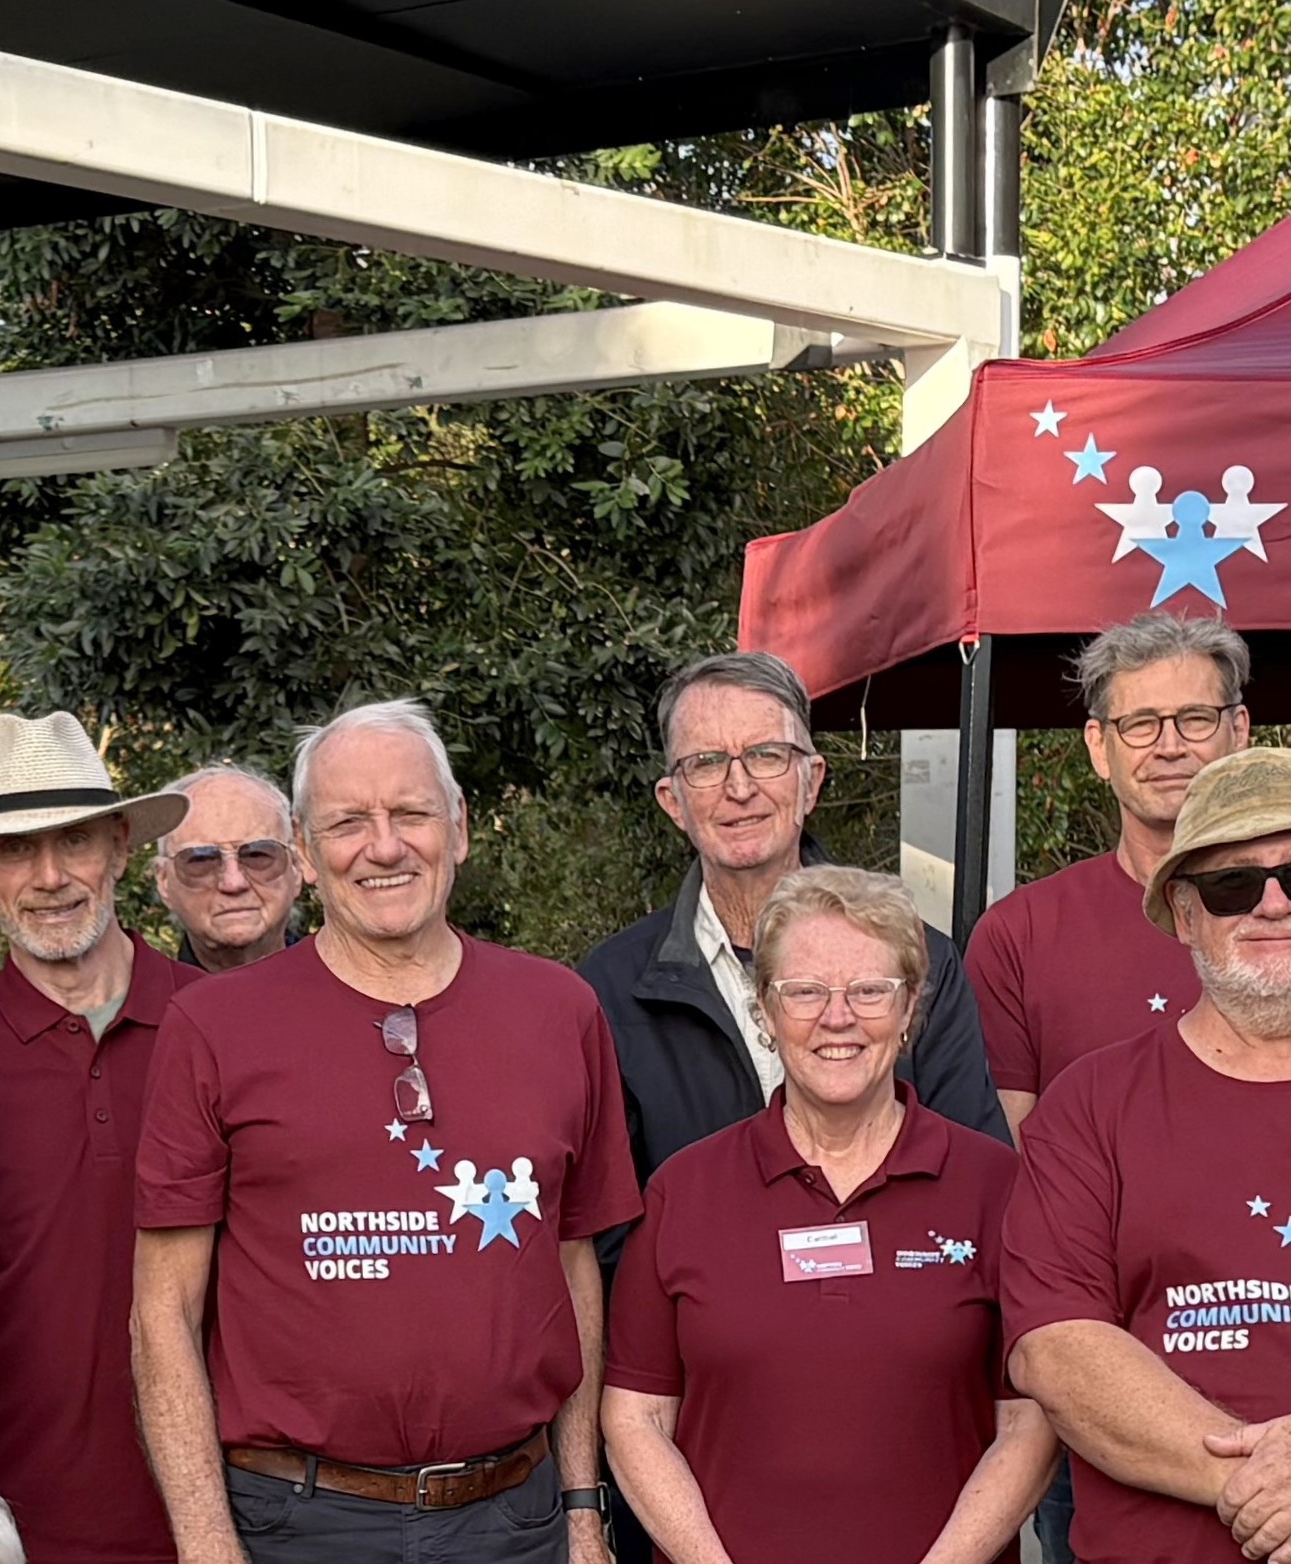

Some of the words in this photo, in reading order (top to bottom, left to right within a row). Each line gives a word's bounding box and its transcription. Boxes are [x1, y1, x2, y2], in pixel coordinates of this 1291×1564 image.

[300, 1211, 439, 1233] NORTHSIDE
[303, 1234, 456, 1257] COMMUNITY
[304, 1259, 390, 1281] VOICES
[1163, 1329, 1250, 1353] VOICES
